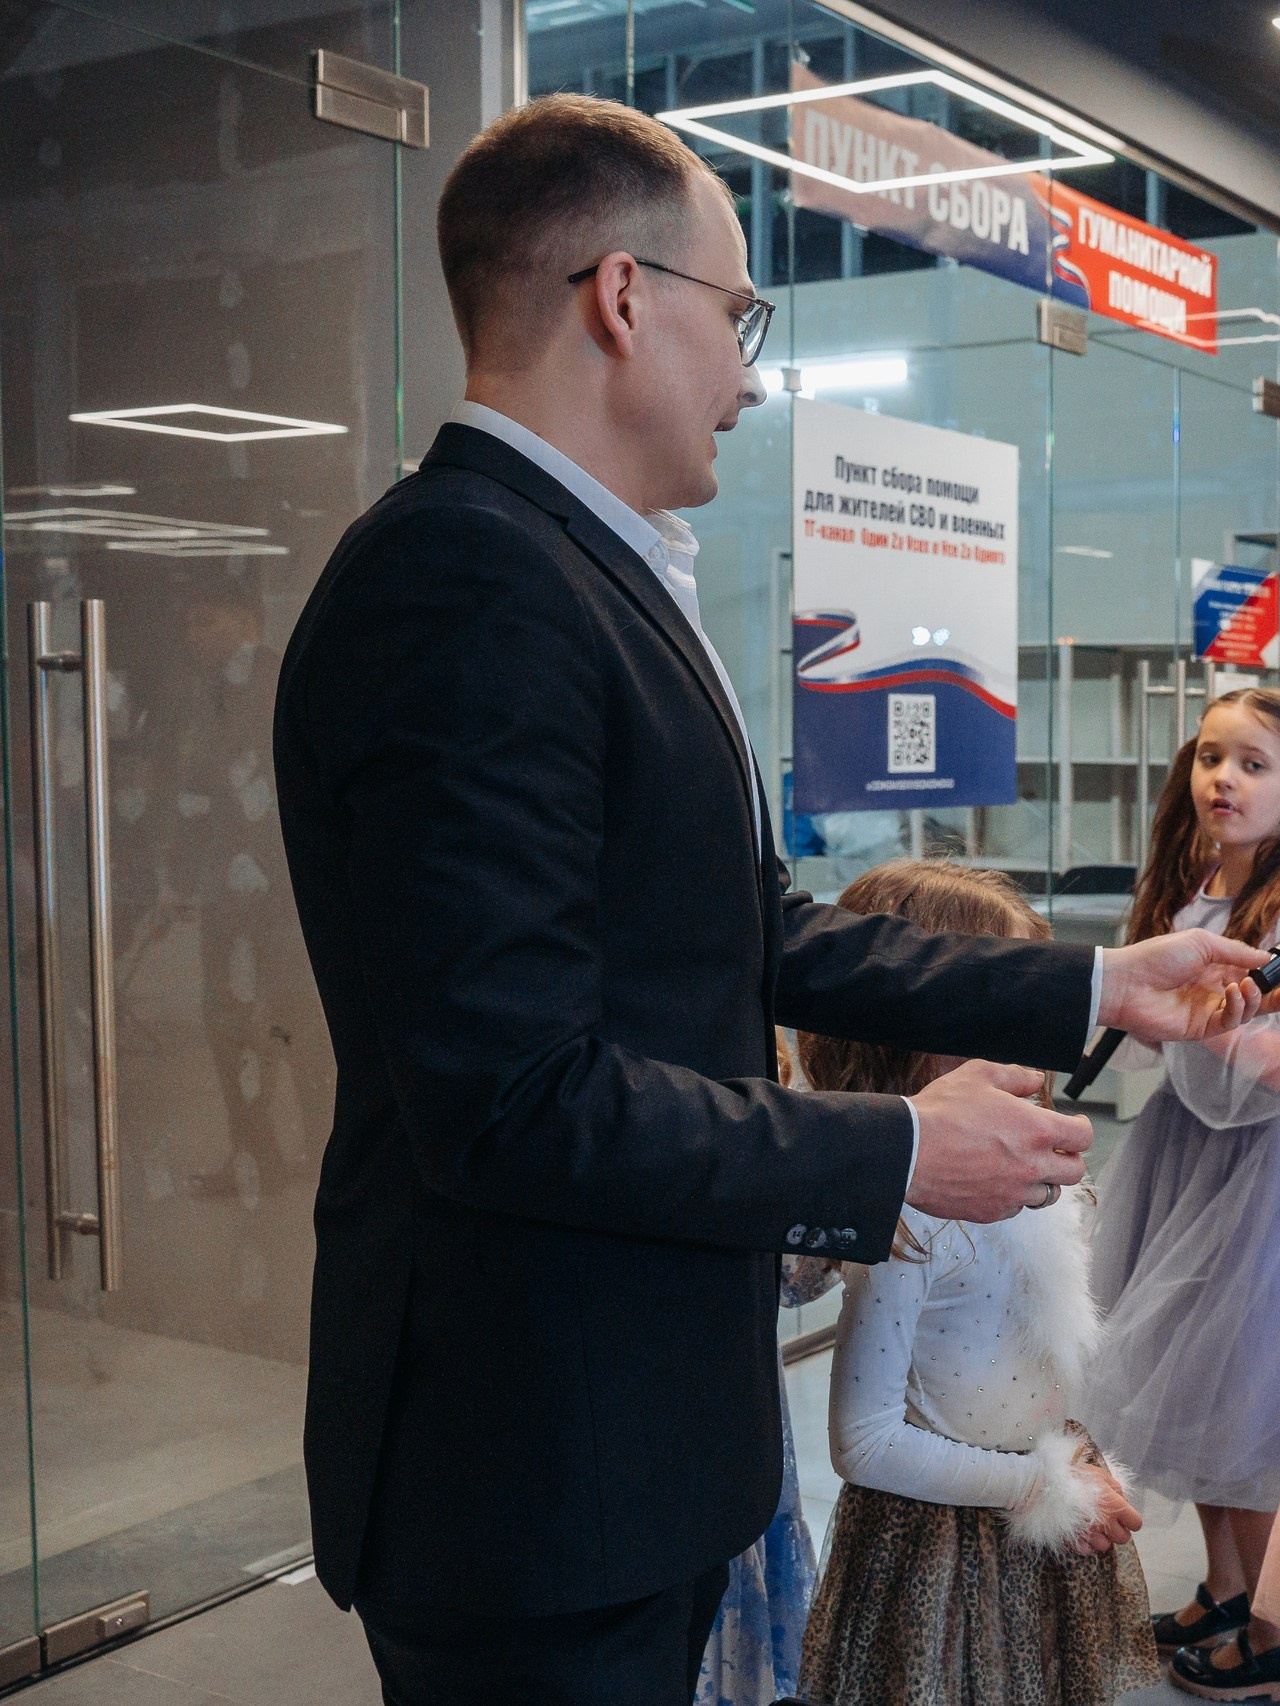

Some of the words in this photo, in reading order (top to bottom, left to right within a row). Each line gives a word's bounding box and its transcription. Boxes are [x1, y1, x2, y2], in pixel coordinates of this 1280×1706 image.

[804, 108, 919, 210] ПУНКТ
[928, 161, 1029, 256] СБОРА
[1078, 206, 1212, 298] ГУМАНИТАРНОЙ
[1109, 270, 1186, 336] ПОМОЩИ
[835, 455, 877, 484] Пункт
[882, 466, 922, 495] сбора
[926, 477, 979, 505] помощи
[804, 489, 834, 512] для
[838, 494, 905, 524] жителей
[910, 503, 936, 528] СВО
[939, 513, 949, 531] и
[952, 514, 1005, 540] военных
